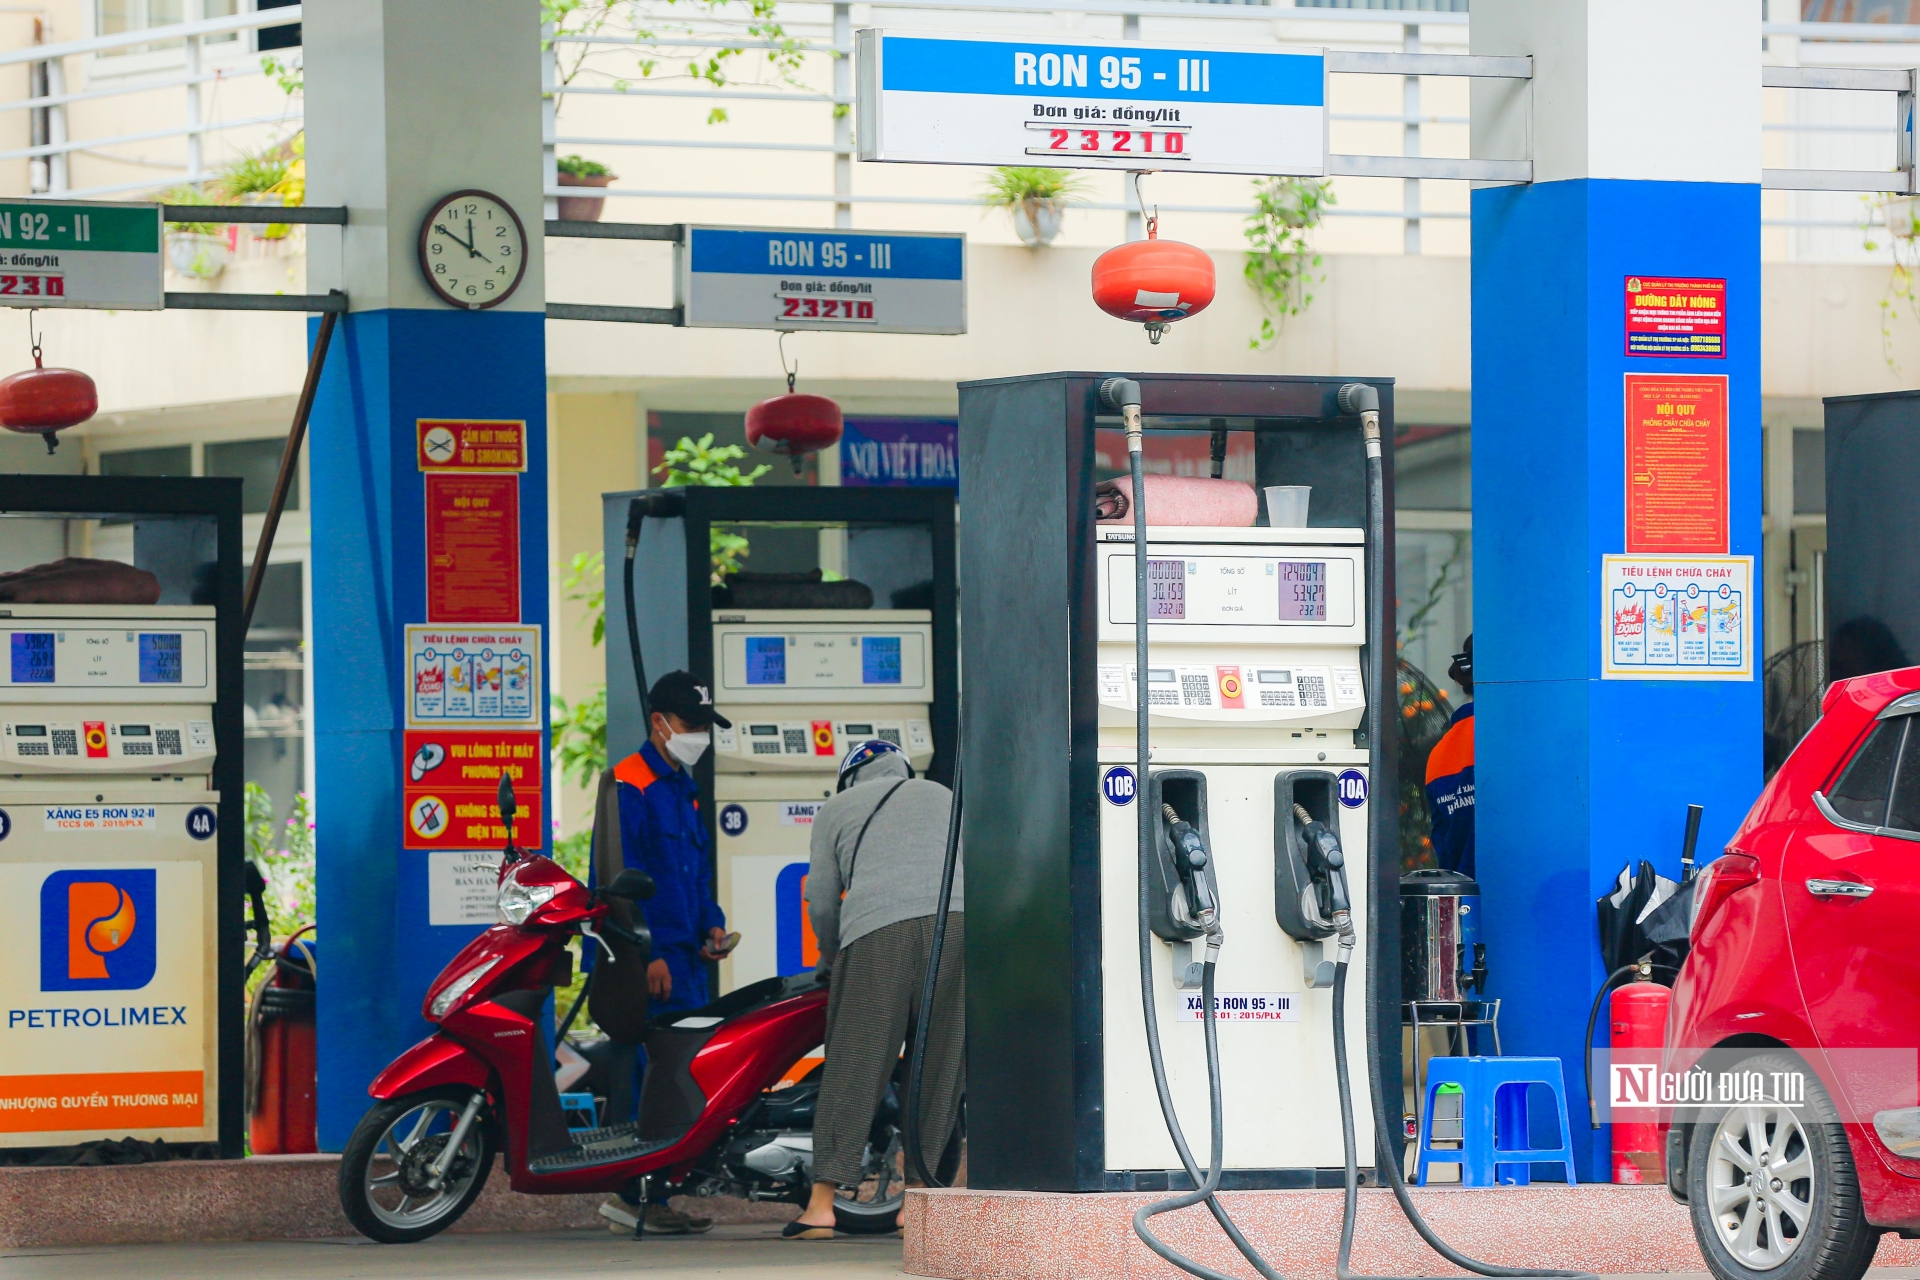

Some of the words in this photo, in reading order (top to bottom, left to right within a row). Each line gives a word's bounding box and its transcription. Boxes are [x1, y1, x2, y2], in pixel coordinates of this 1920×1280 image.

[1014, 52, 1088, 87] RON
[1100, 56, 1142, 90] 95
[1178, 58, 1210, 92] III
[1032, 104, 1067, 118] Đơn
[1074, 105, 1106, 120] giá:
[1112, 105, 1181, 122] đồng/lít
[1050, 128, 1184, 154] 23210
[448, 209, 458, 219] 11
[464, 204, 477, 215] 12
[487, 209, 492, 220] 1
[19, 212, 50, 241] 92
[74, 214, 90, 242] II
[496, 226, 506, 237] 2
[432, 244, 443, 254] 9
[501, 246, 511, 256] 3
[768, 240, 814, 268] RON
[822, 242, 848, 268] 95
[870, 243, 891, 270] III
[12, 253, 59, 268] đồng/lít
[435, 263, 446, 274] 8
[496, 265, 506, 275] 4
[0, 274, 64, 296] 230
[448, 279, 458, 289] 7
[466, 285, 477, 296] 6
[484, 280, 495, 290] 5
[780, 280, 802, 292] Đơn
[806, 280, 826, 293] giá:
[830, 281, 872, 294] đồng/lít
[1635, 293, 1667, 307] ĐƯỜNG
[1669, 294, 1688, 308] DÂY
[1690, 294, 1716, 308] NÓNG
[784, 298, 873, 318] 23210
[1656, 402, 1674, 416] NỘI
[1676, 404, 1696, 416] QUY
[1643, 418, 1662, 427] PHÒNG
[1663, 418, 1678, 427] CHÁY
[1695, 418, 1710, 427] CHÁY
[462, 449, 475, 464] NO
[477, 449, 518, 464] SMOKING
[1622, 566, 1643, 577] TIÊU
[1646, 566, 1672, 578] LỆNH
[1676, 566, 1702, 578] CHỮA
[1706, 566, 1732, 578] CHÁY
[1227, 587, 1237, 595] LÍT
[1627, 586, 1632, 594] 1
[1658, 586, 1665, 595] 2
[1690, 587, 1696, 595] 3
[1721, 587, 1728, 596] 4
[1158, 603, 1184, 614] 23210
[1299, 605, 1324, 616] 23210
[1617, 623, 1642, 634] ĐỘNG
[423, 634, 443, 644] TIÊU
[499, 634, 522, 644] CHÁY
[450, 745, 466, 758] VUI
[468, 742, 493, 758] LÒNG
[494, 740, 512, 758] TẮT
[513, 742, 534, 758] MÁY
[462, 765, 500, 778] PHƯƠNG
[1106, 776, 1133, 796] 10B
[1339, 779, 1365, 800] 10A
[46, 806, 82, 819] XĂNG
[85, 809, 100, 819] E5
[102, 809, 128, 818] RON
[455, 802, 487, 818] KHÔNG
[102, 820, 143, 828] 2015/PLX
[192, 814, 210, 833] 4A
[725, 812, 742, 830] 3B
[467, 823, 490, 841] ĐIỆN
[491, 825, 518, 839] THOI
[476, 876, 499, 886] HÀN
[1187, 995, 1219, 1010] XĂG
[1223, 998, 1247, 1010] RON
[1252, 998, 1266, 1010] 95
[1278, 998, 1289, 1010] III
[9, 1006, 187, 1028] PETROLIMEX
[494, 1029, 526, 1038] HONDA
[0, 1096, 57, 1113] NHƯỢNG
[61, 1091, 108, 1108] QUYỀN
[112, 1093, 168, 1107] THƯƠNG
[172, 1093, 198, 1108] MẠI
